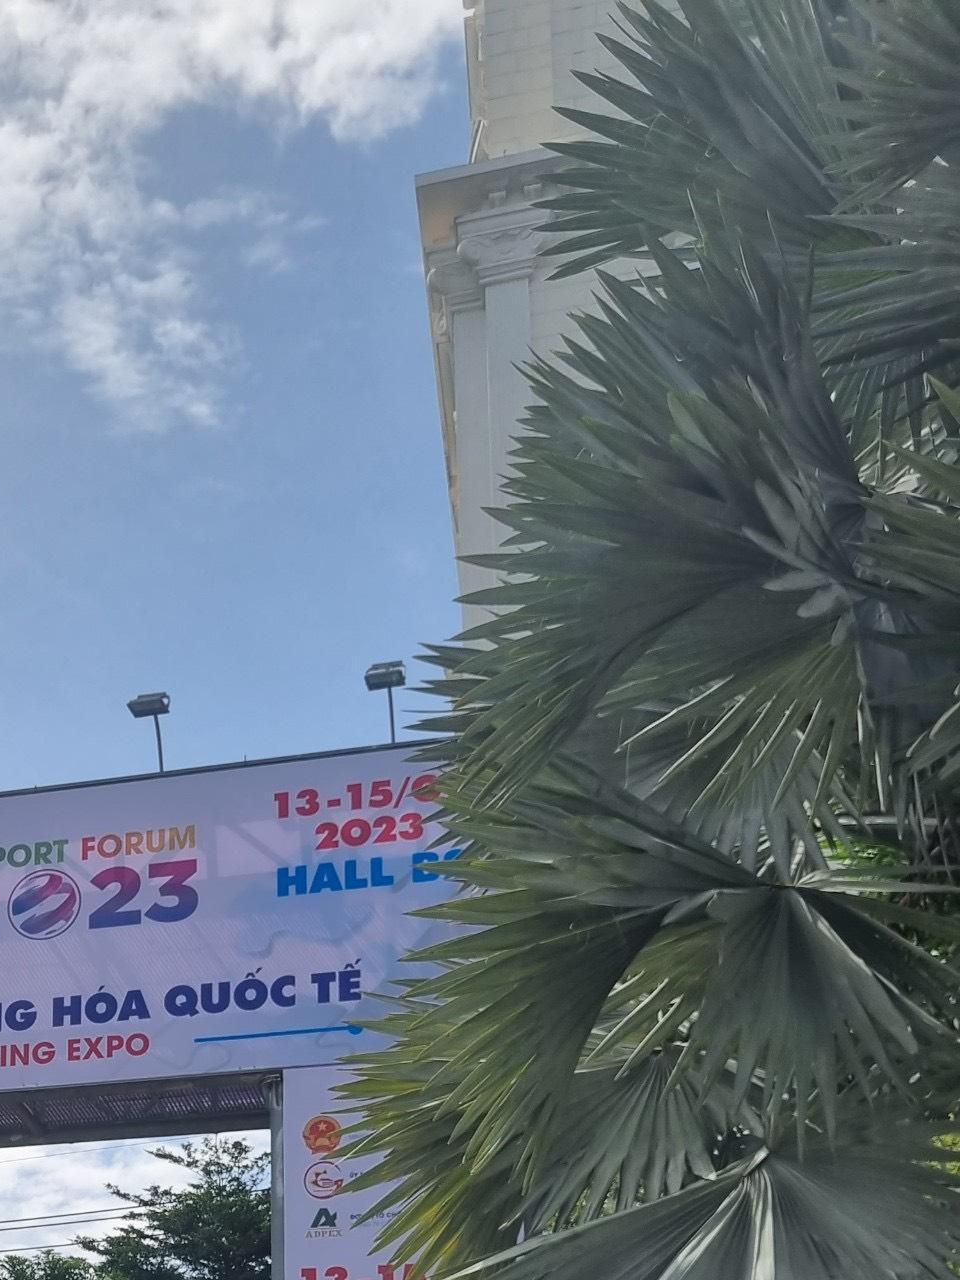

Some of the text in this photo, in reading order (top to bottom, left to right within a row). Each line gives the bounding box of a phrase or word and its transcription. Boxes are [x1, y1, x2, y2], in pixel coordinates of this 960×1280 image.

[274, 774, 440, 818] 13-15/0
[81, 825, 196, 860] FORUM
[316, 813, 423, 850] 2023
[277, 849, 461, 897] HALL B
[52, 985, 151, 1027] HÓA
[164, 967, 296, 1018] QUỐC
[311, 958, 362, 1003] TẾ
[67, 1032, 149, 1063] EXPO
